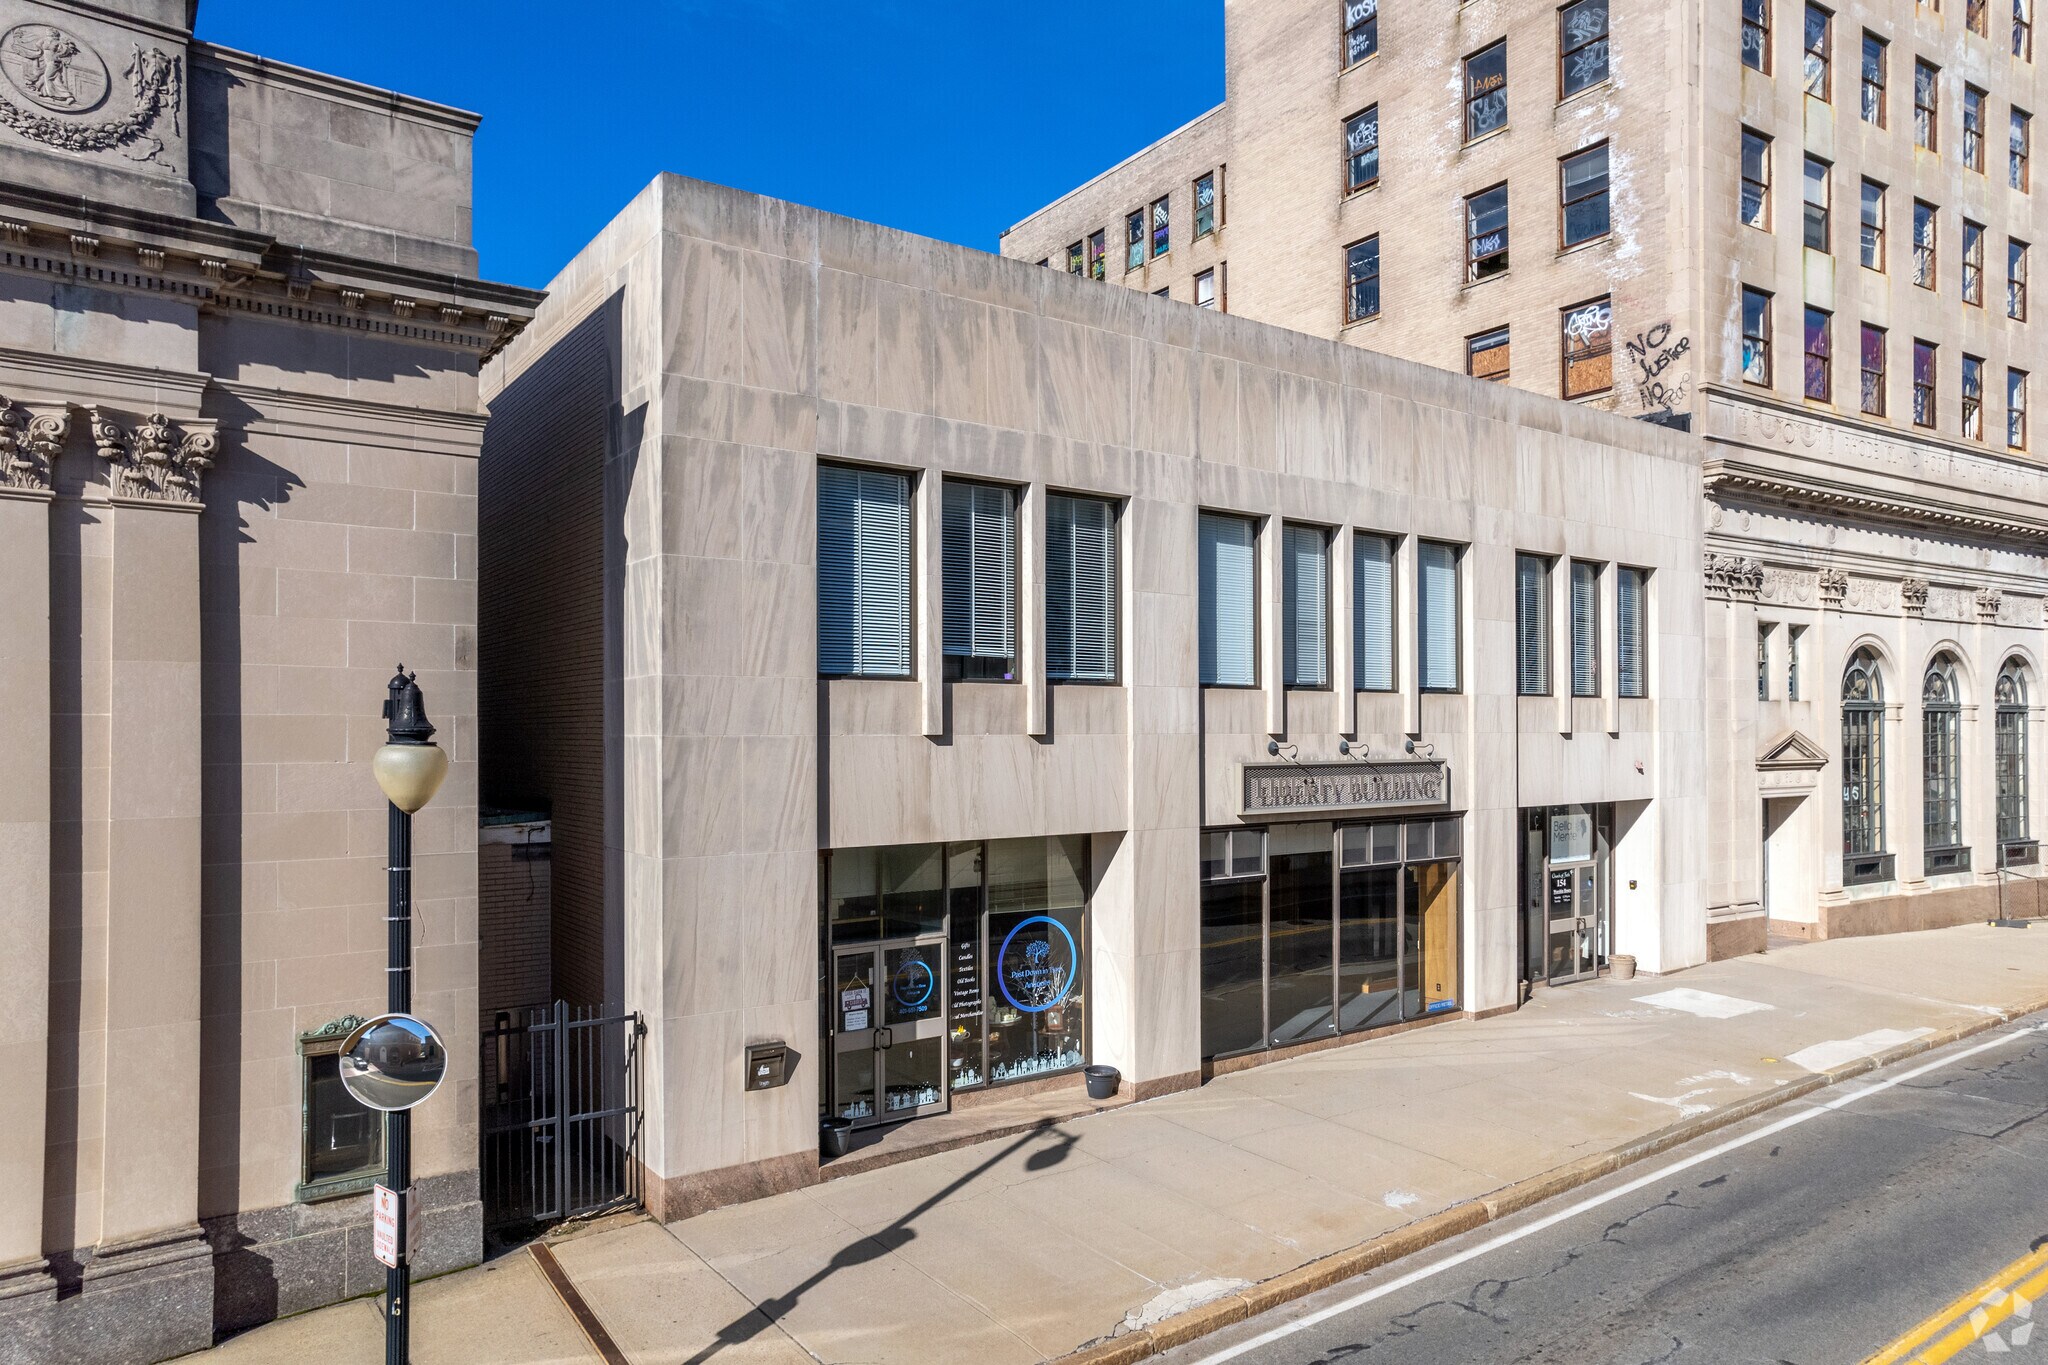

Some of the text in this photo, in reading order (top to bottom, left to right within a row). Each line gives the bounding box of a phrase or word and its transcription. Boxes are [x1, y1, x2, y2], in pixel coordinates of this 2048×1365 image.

[1256, 773, 1440, 801] LIBERTY BUILDING
[1556, 879, 1567, 887] 154
[961, 942, 970, 950] Gifts
[958, 953, 973, 961] Candles
[381, 1197, 389, 1211] NO
[376, 1210, 394, 1227] PARKING
